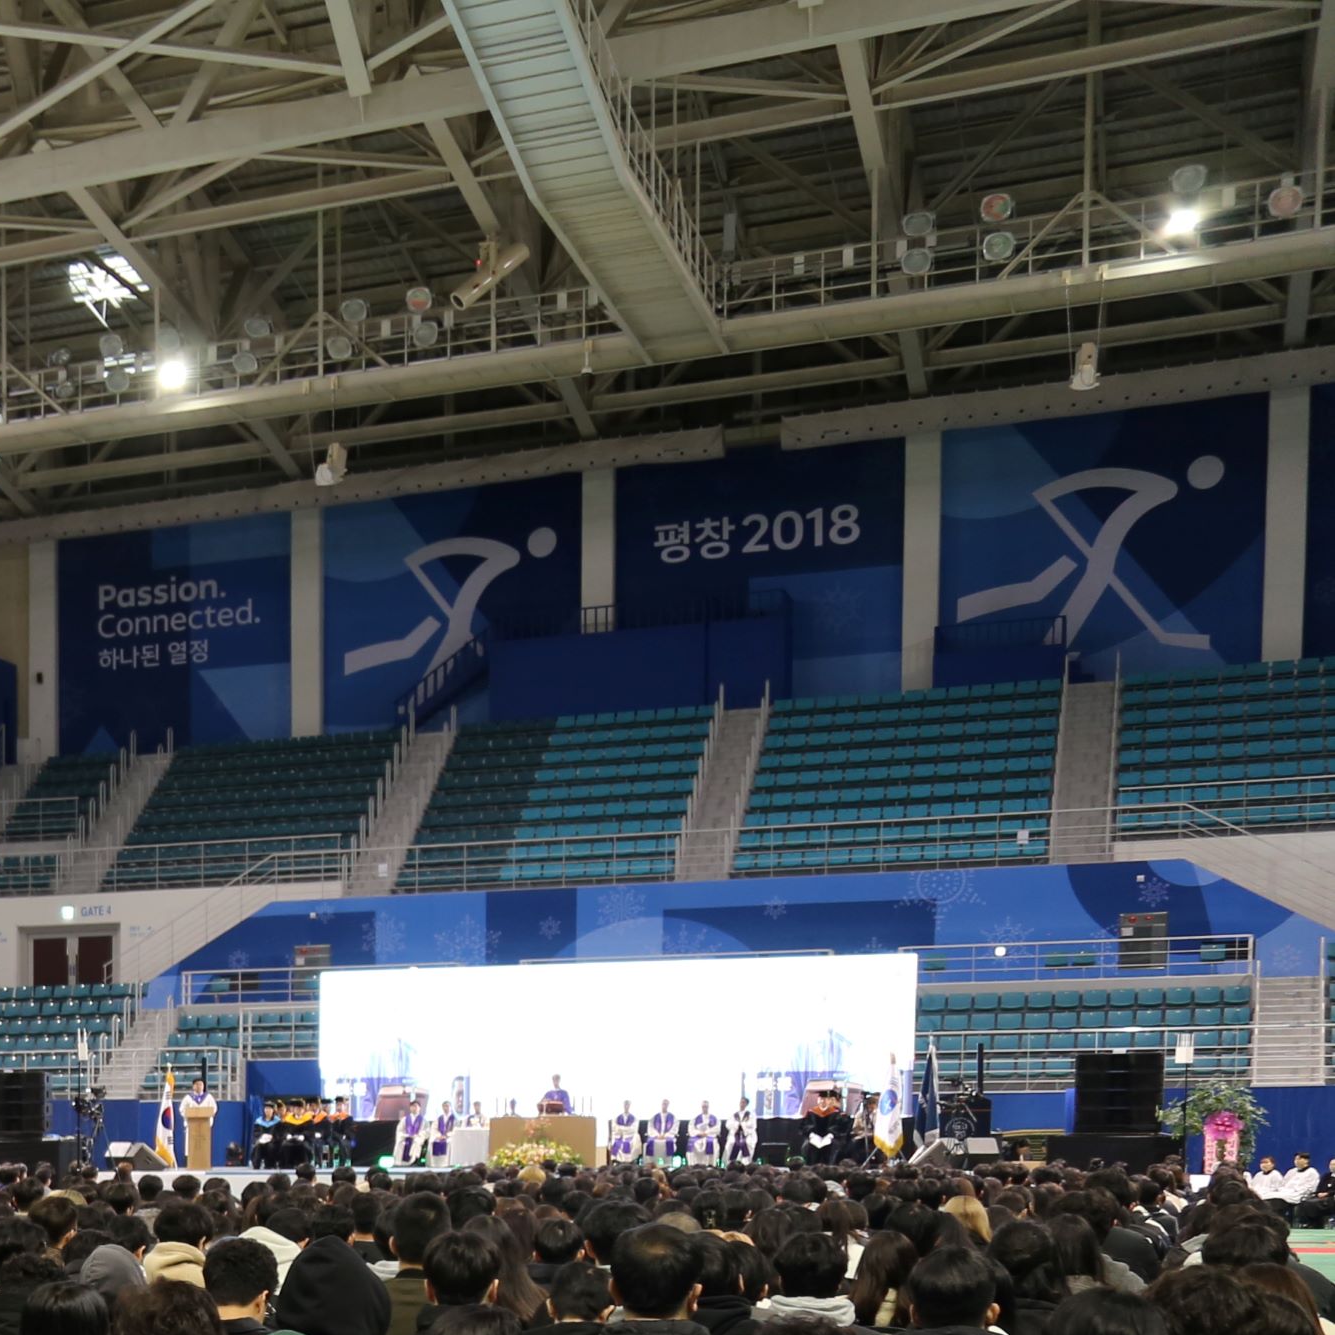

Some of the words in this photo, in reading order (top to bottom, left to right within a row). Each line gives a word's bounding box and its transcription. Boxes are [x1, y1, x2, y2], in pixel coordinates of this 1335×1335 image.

[653, 516, 736, 564] 평창
[741, 503, 861, 553] 2018
[98, 576, 227, 611] Passion.
[97, 598, 261, 639] Connected.
[98, 643, 161, 670] 하나된
[168, 639, 209, 665] 열정
[81, 905, 104, 917] GATE
